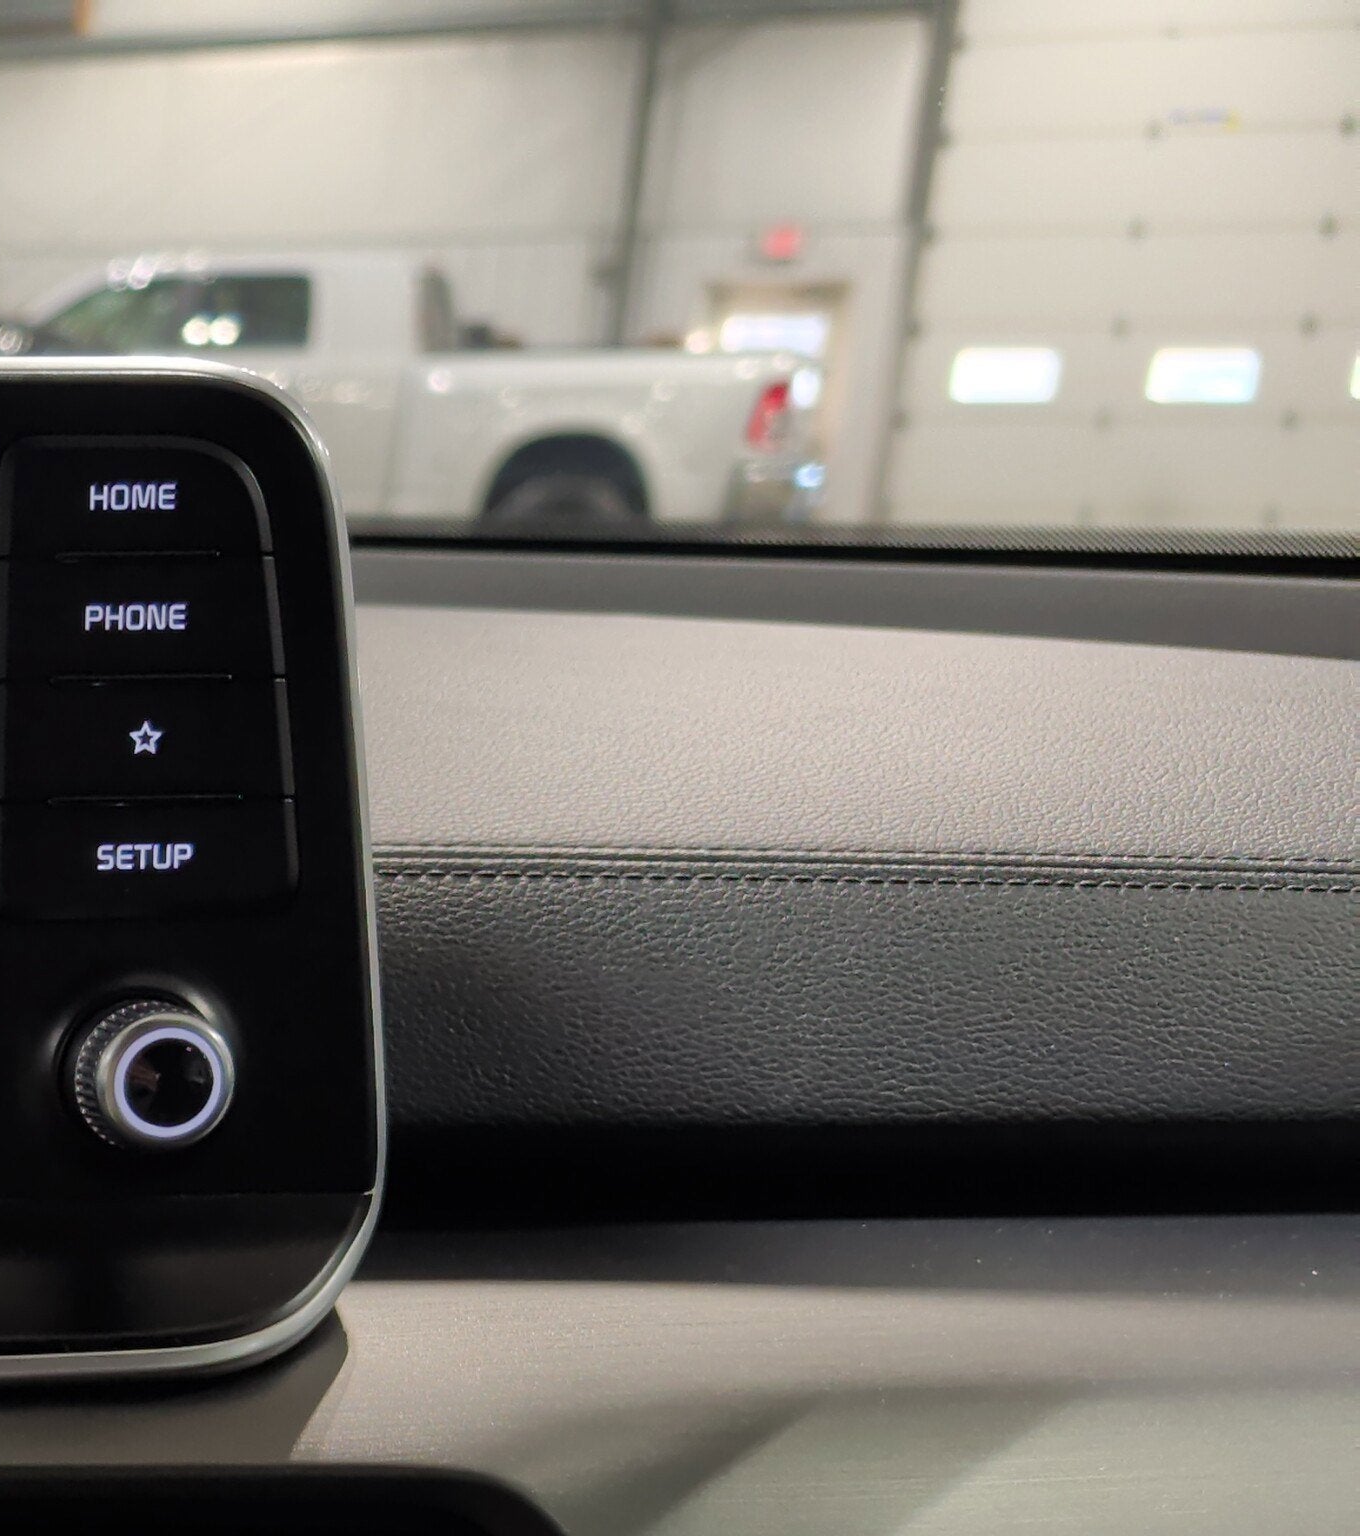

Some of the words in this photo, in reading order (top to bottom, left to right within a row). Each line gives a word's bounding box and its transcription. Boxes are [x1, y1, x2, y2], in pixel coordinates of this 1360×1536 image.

[89, 483, 177, 511] HOME
[84, 603, 187, 631] PHONE
[96, 843, 194, 871] SETUP
